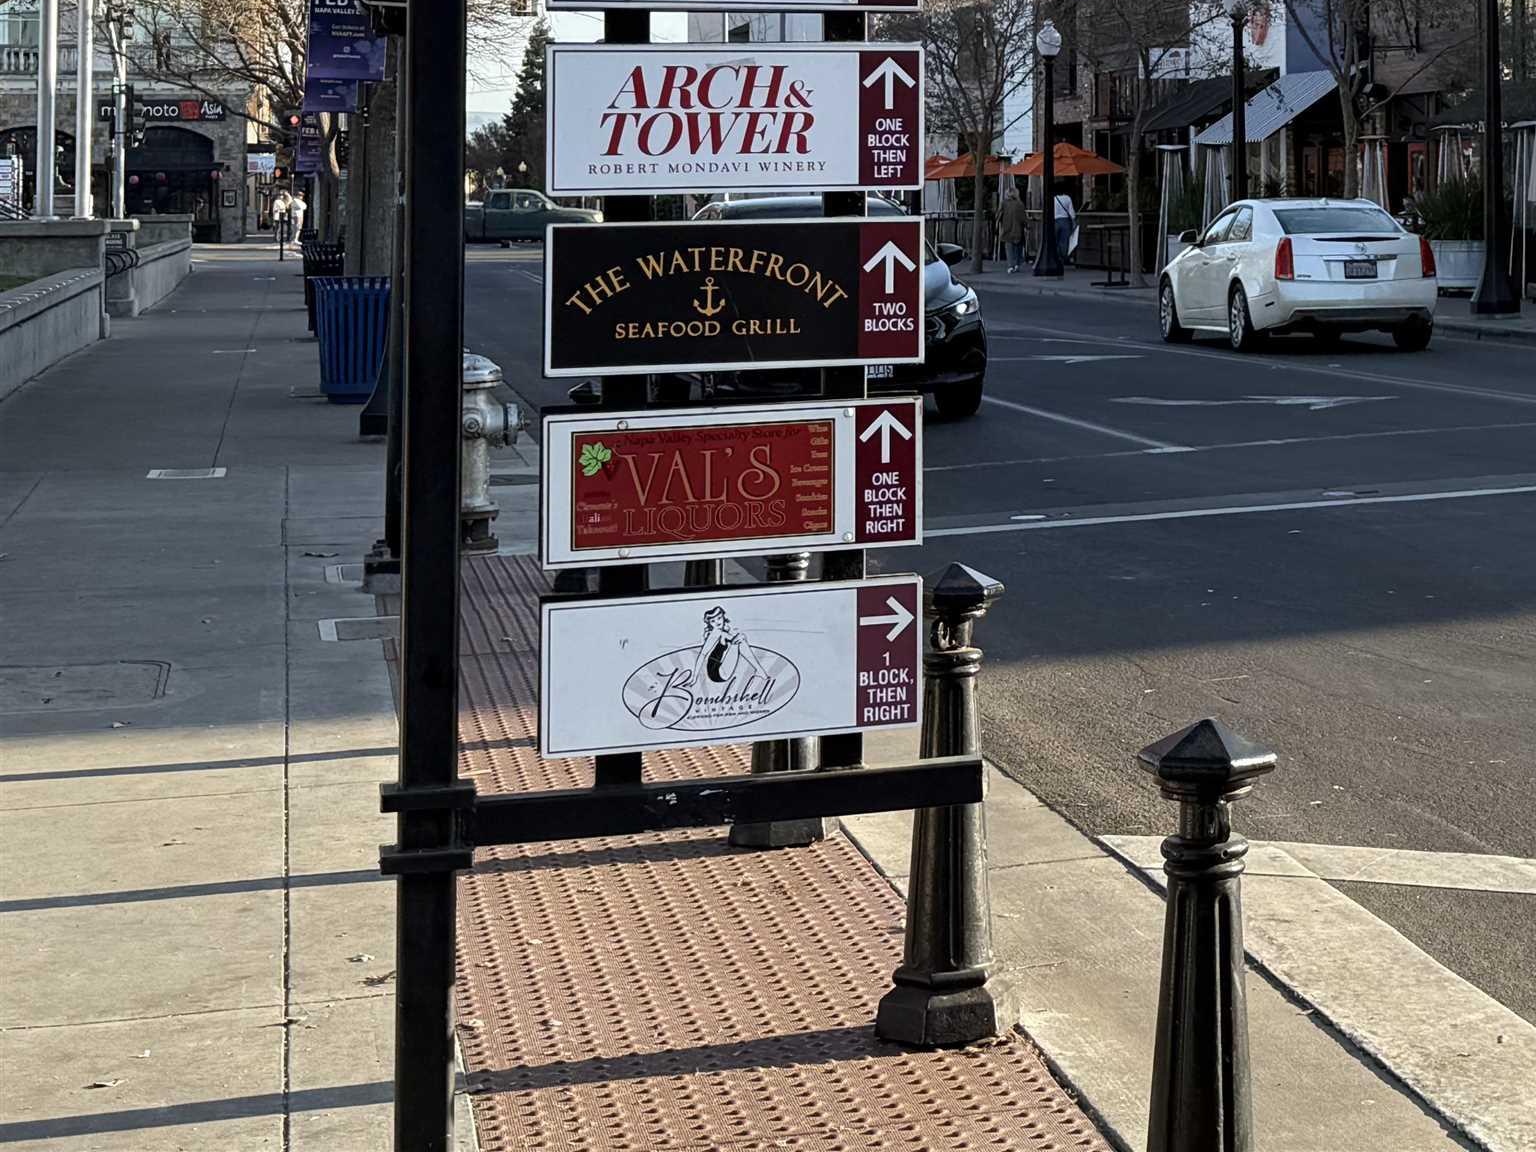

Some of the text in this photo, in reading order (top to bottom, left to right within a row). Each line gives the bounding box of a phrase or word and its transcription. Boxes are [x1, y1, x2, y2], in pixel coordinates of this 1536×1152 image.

[200, 101, 223, 115] Asia
[875, 119, 903, 131] ONE
[599, 111, 815, 157] TOWER
[867, 134, 910, 147] BLOCK
[871, 150, 906, 163] THEN
[588, 161, 827, 175] ROBERT MONDAVI WINERY
[874, 165, 903, 178] LEFT
[565, 247, 849, 316] THE WATERFRONT
[873, 303, 906, 316] TWO
[615, 318, 801, 339] SEAFOOD GRILL
[864, 318, 914, 332] BLOCKS
[618, 443, 782, 506] VAL'S
[872, 473, 900, 486] ONE
[864, 488, 906, 501] BLOCK
[868, 503, 903, 517] THEN
[622, 499, 787, 540] LIQUORS
[865, 519, 905, 533] RIGHT
[882, 652, 890, 666] 1
[860, 669, 914, 687] BLOCK,
[638, 667, 776, 730] Bombshell
[867, 687, 907, 703] THEN
[863, 705, 911, 723] RIGHT
